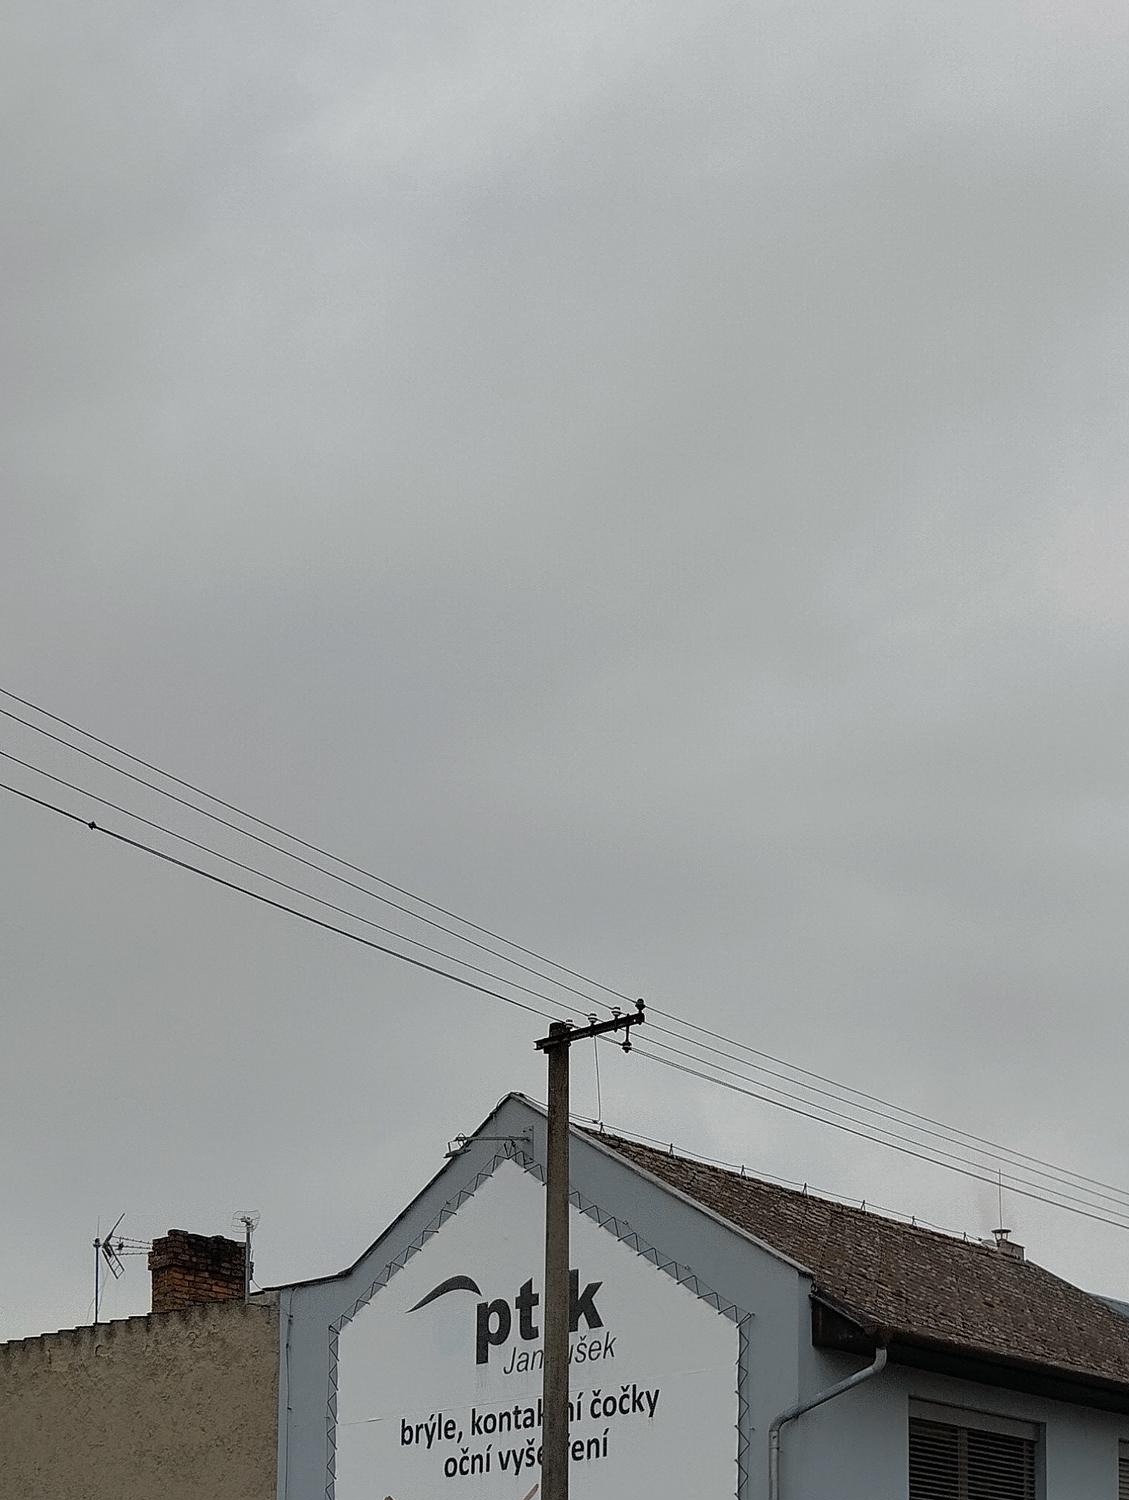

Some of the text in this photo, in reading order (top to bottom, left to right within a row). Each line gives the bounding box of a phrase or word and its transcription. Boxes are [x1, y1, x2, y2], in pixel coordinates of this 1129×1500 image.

[503, 1331, 617, 1375] Janšek
[400, 1383, 660, 1450] brýle, kontakní čočky
[444, 1427, 610, 1478] oční vyšení
